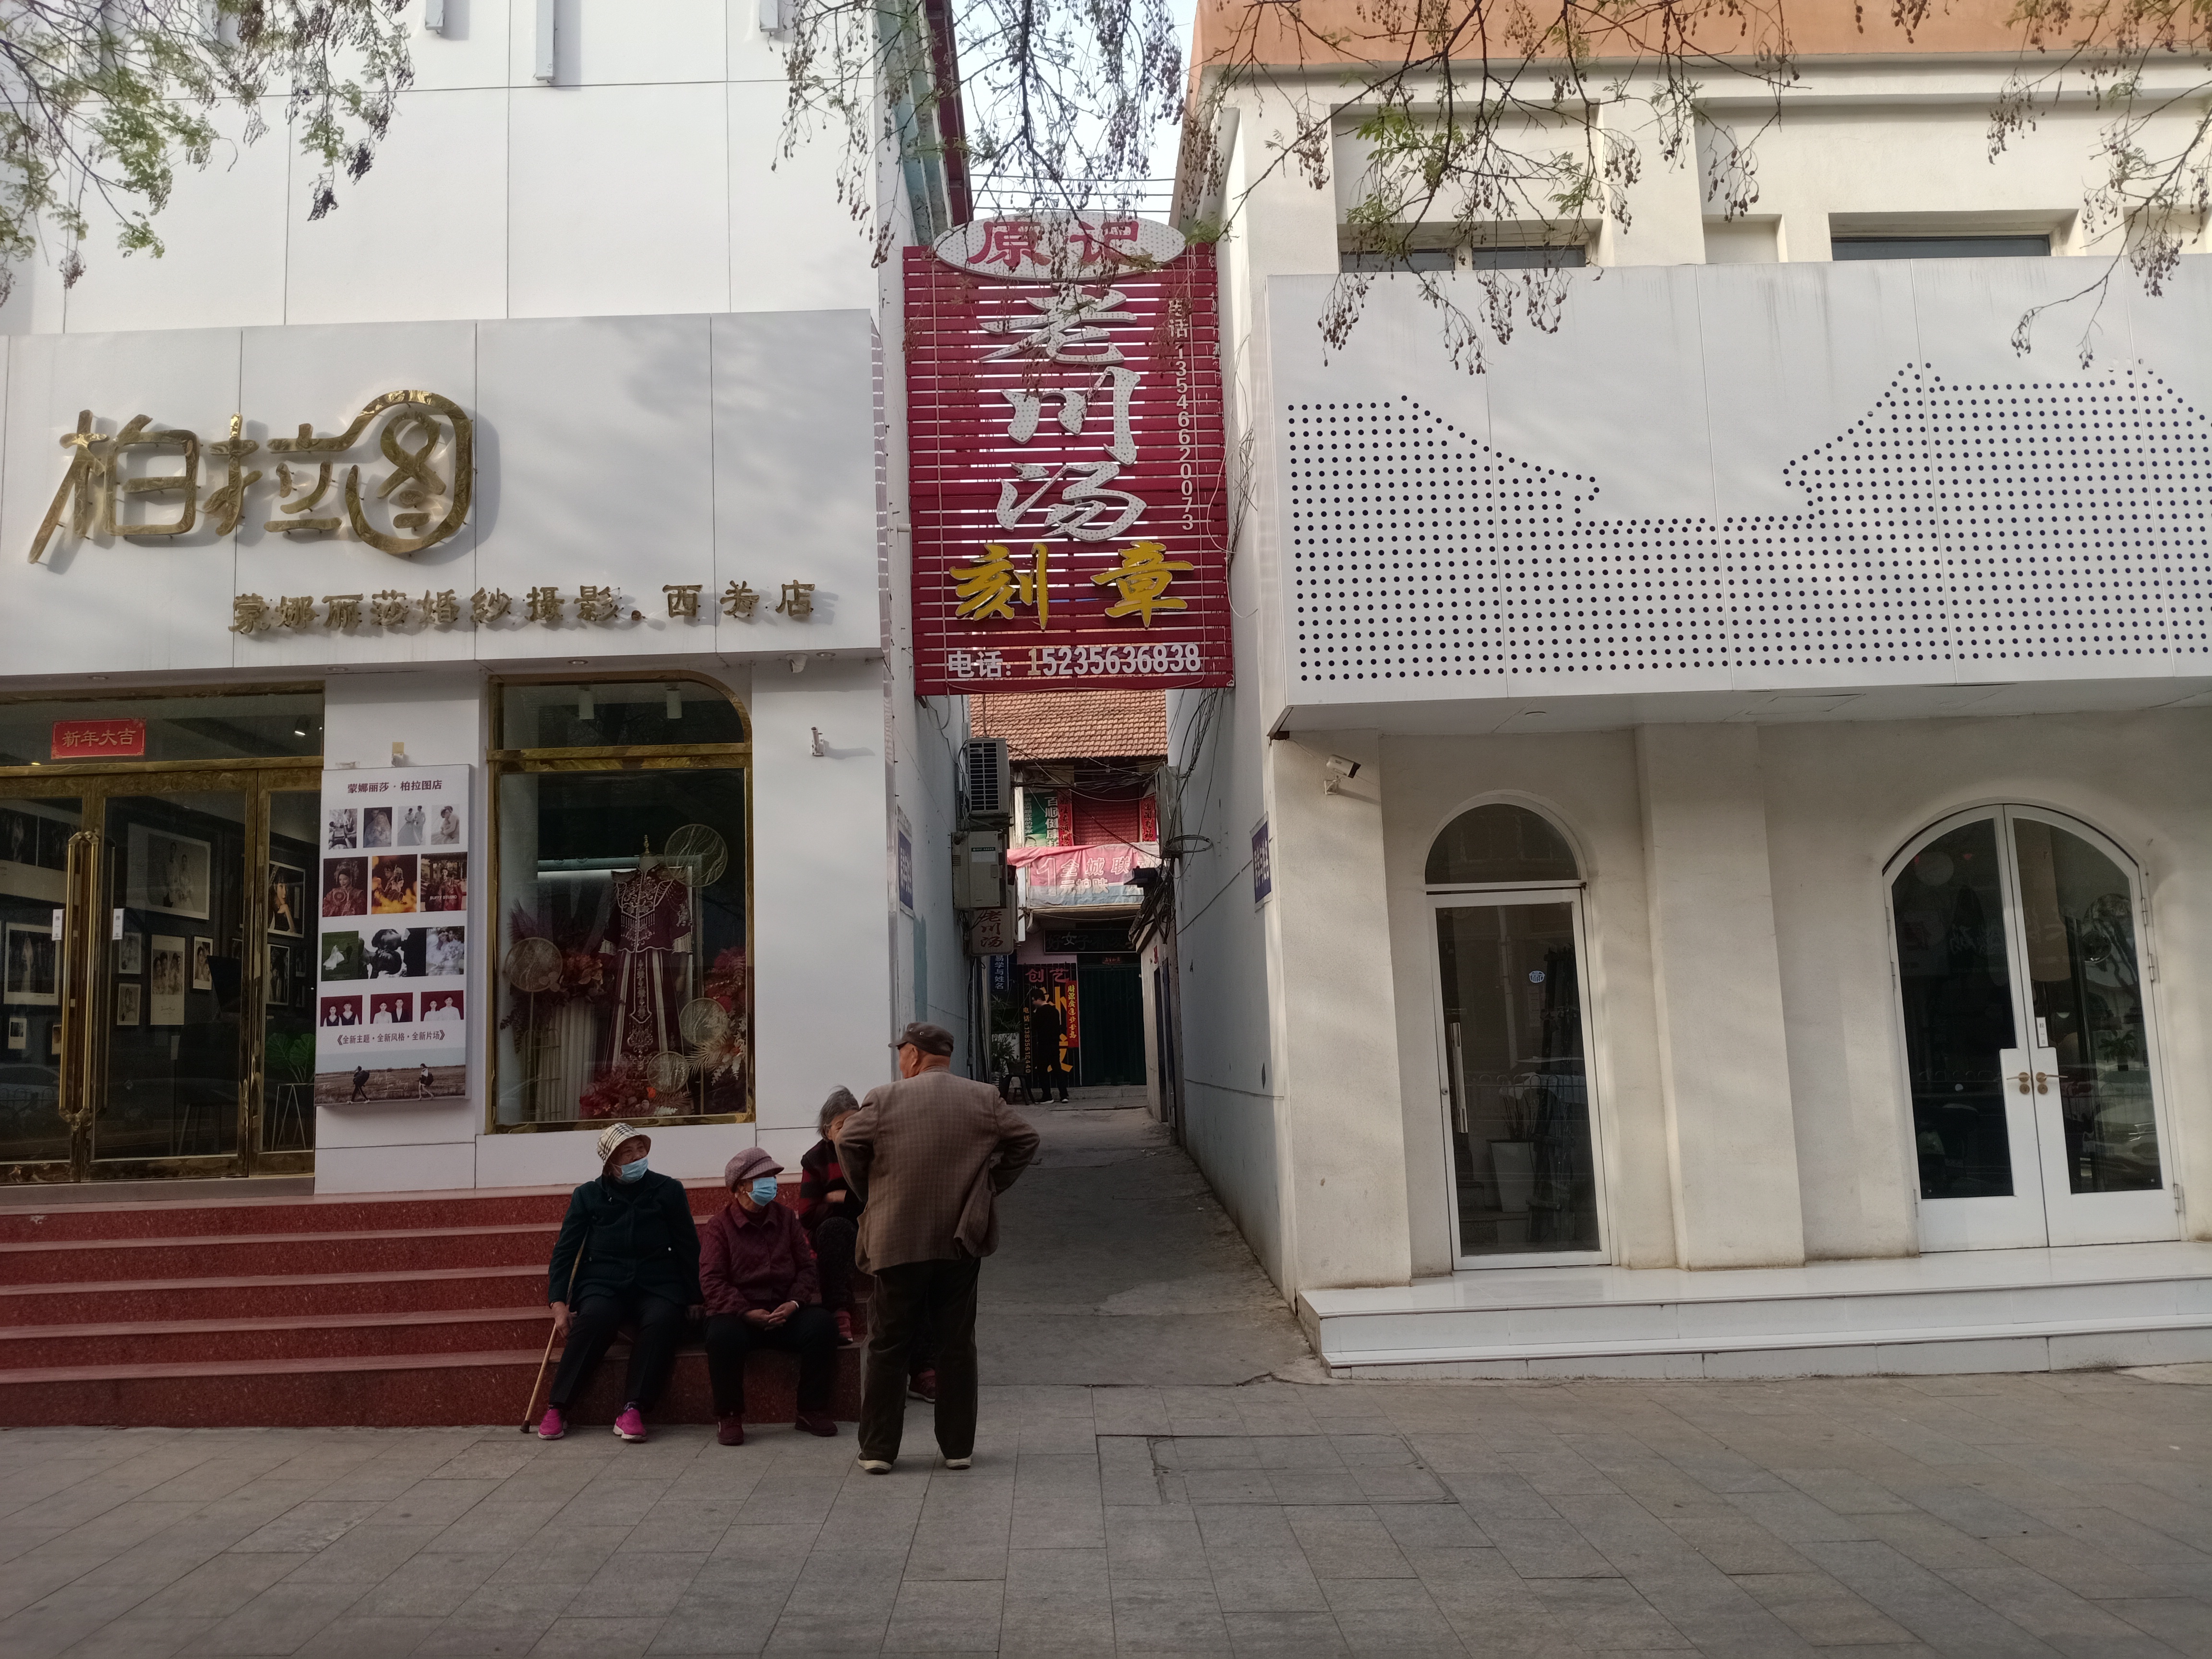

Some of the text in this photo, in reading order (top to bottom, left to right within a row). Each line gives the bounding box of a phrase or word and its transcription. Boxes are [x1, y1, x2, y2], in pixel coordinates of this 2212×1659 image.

[949, 540, 1195, 632] 刻章
[62, 728, 136, 747] 新年大吉
[1059, 878, 1141, 896] 元护肤一
[980, 910, 1004, 948] 老川汤
[994, 955, 1005, 990] 易学与姓名
[1025, 968, 1070, 983] 创艺
